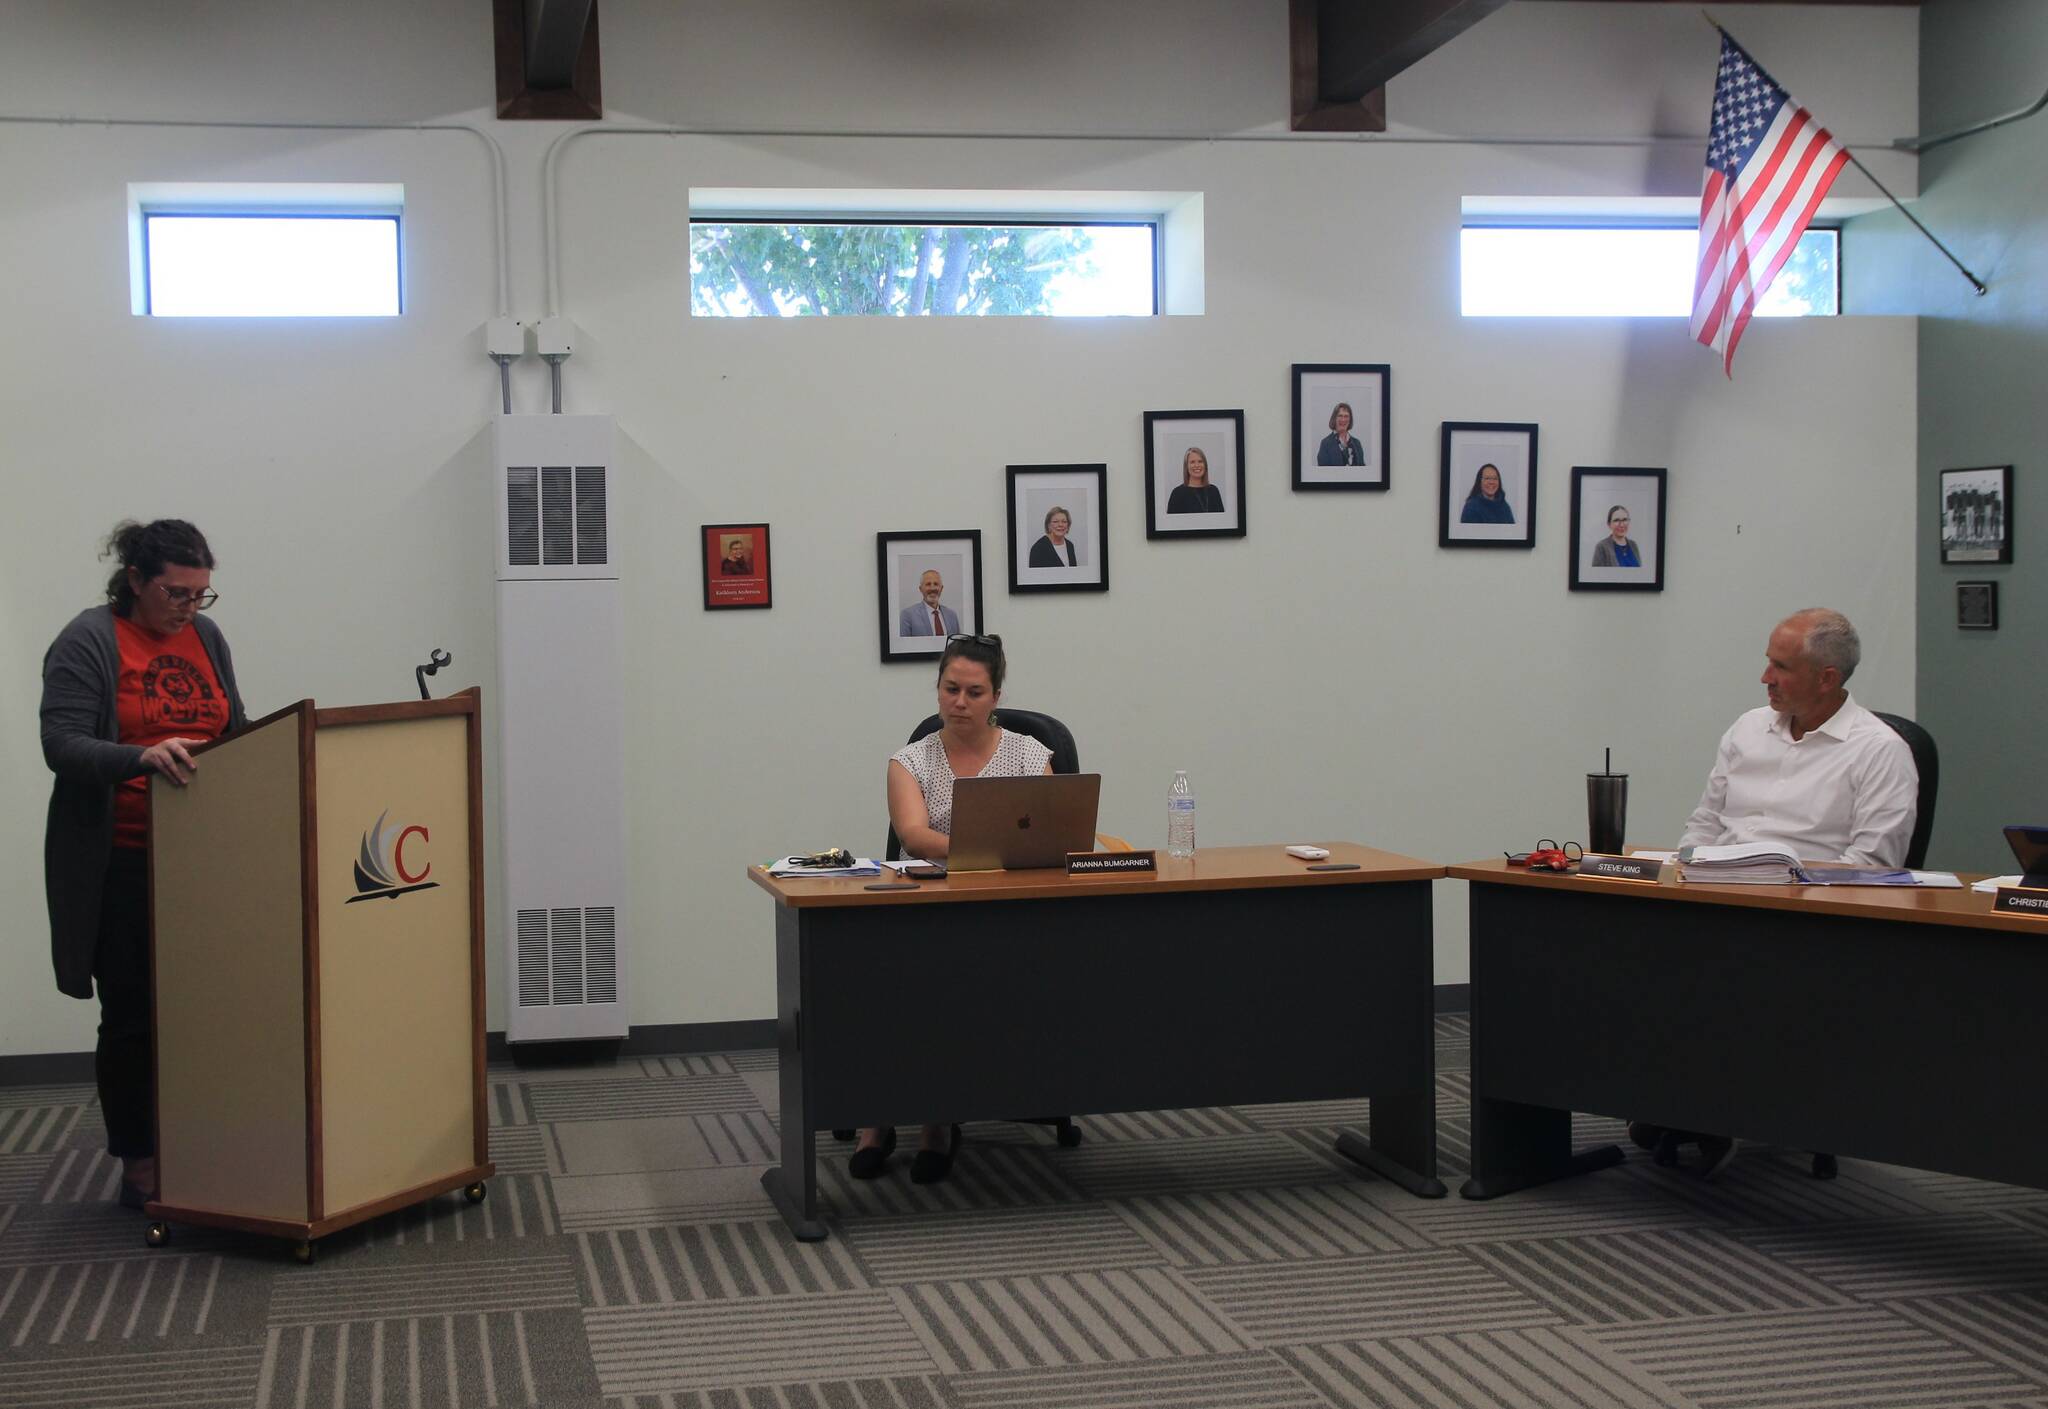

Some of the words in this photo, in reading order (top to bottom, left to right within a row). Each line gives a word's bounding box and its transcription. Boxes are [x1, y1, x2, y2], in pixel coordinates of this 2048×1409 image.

[141, 695, 222, 725] WOLVES
[395, 825, 431, 884] C
[1104, 859, 1150, 867] BUMGARNER
[1598, 863, 1622, 872] STEVE
[1622, 865, 1641, 874] KING
